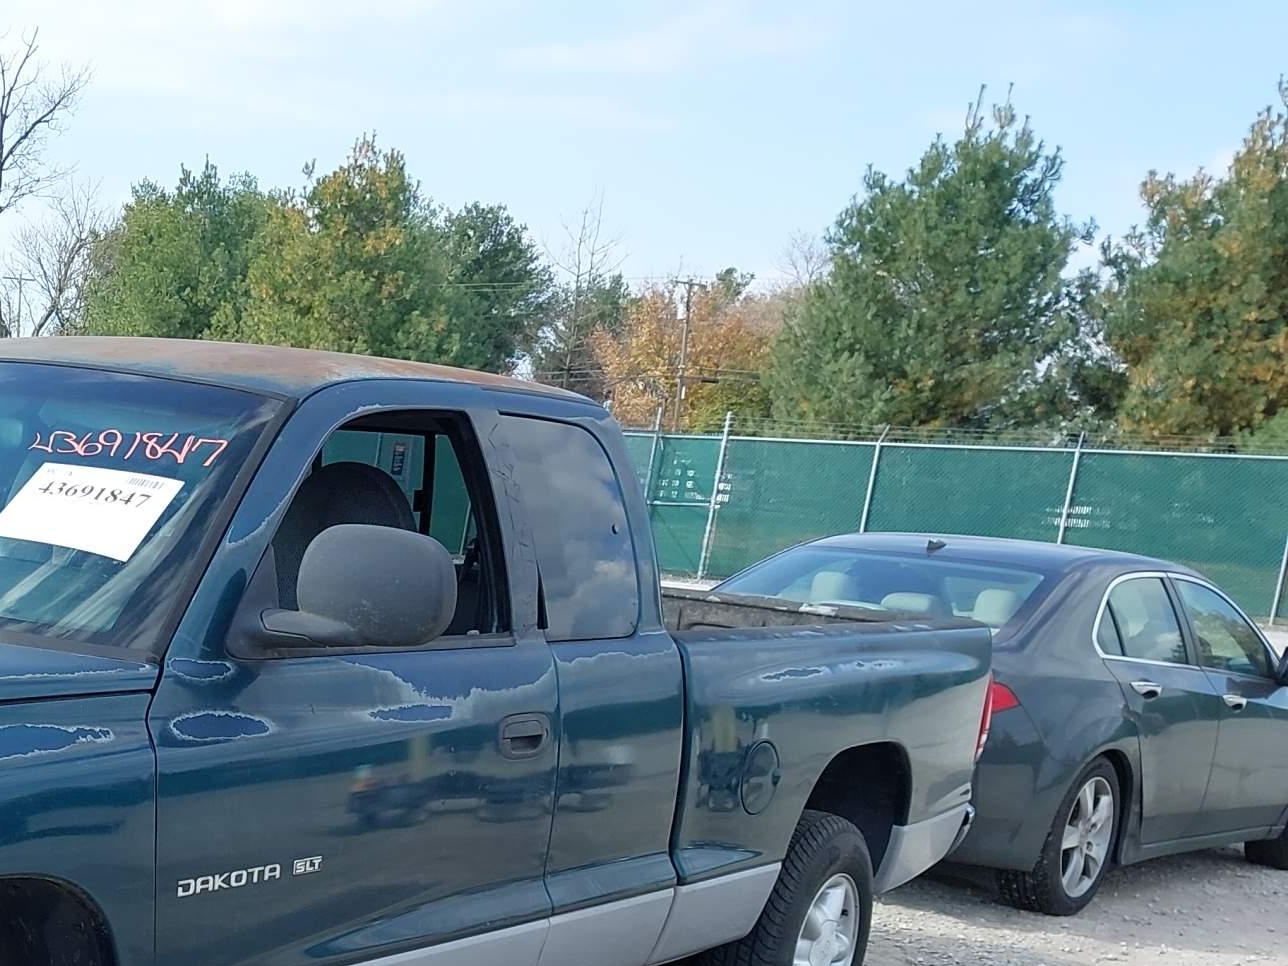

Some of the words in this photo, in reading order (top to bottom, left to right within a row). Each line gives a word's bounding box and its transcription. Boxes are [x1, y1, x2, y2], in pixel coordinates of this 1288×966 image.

[28, 429, 228, 467] 43691847
[38, 480, 152, 508] 43691847
[177, 863, 281, 897] DAKOTA
[294, 857, 323, 874] SLT
